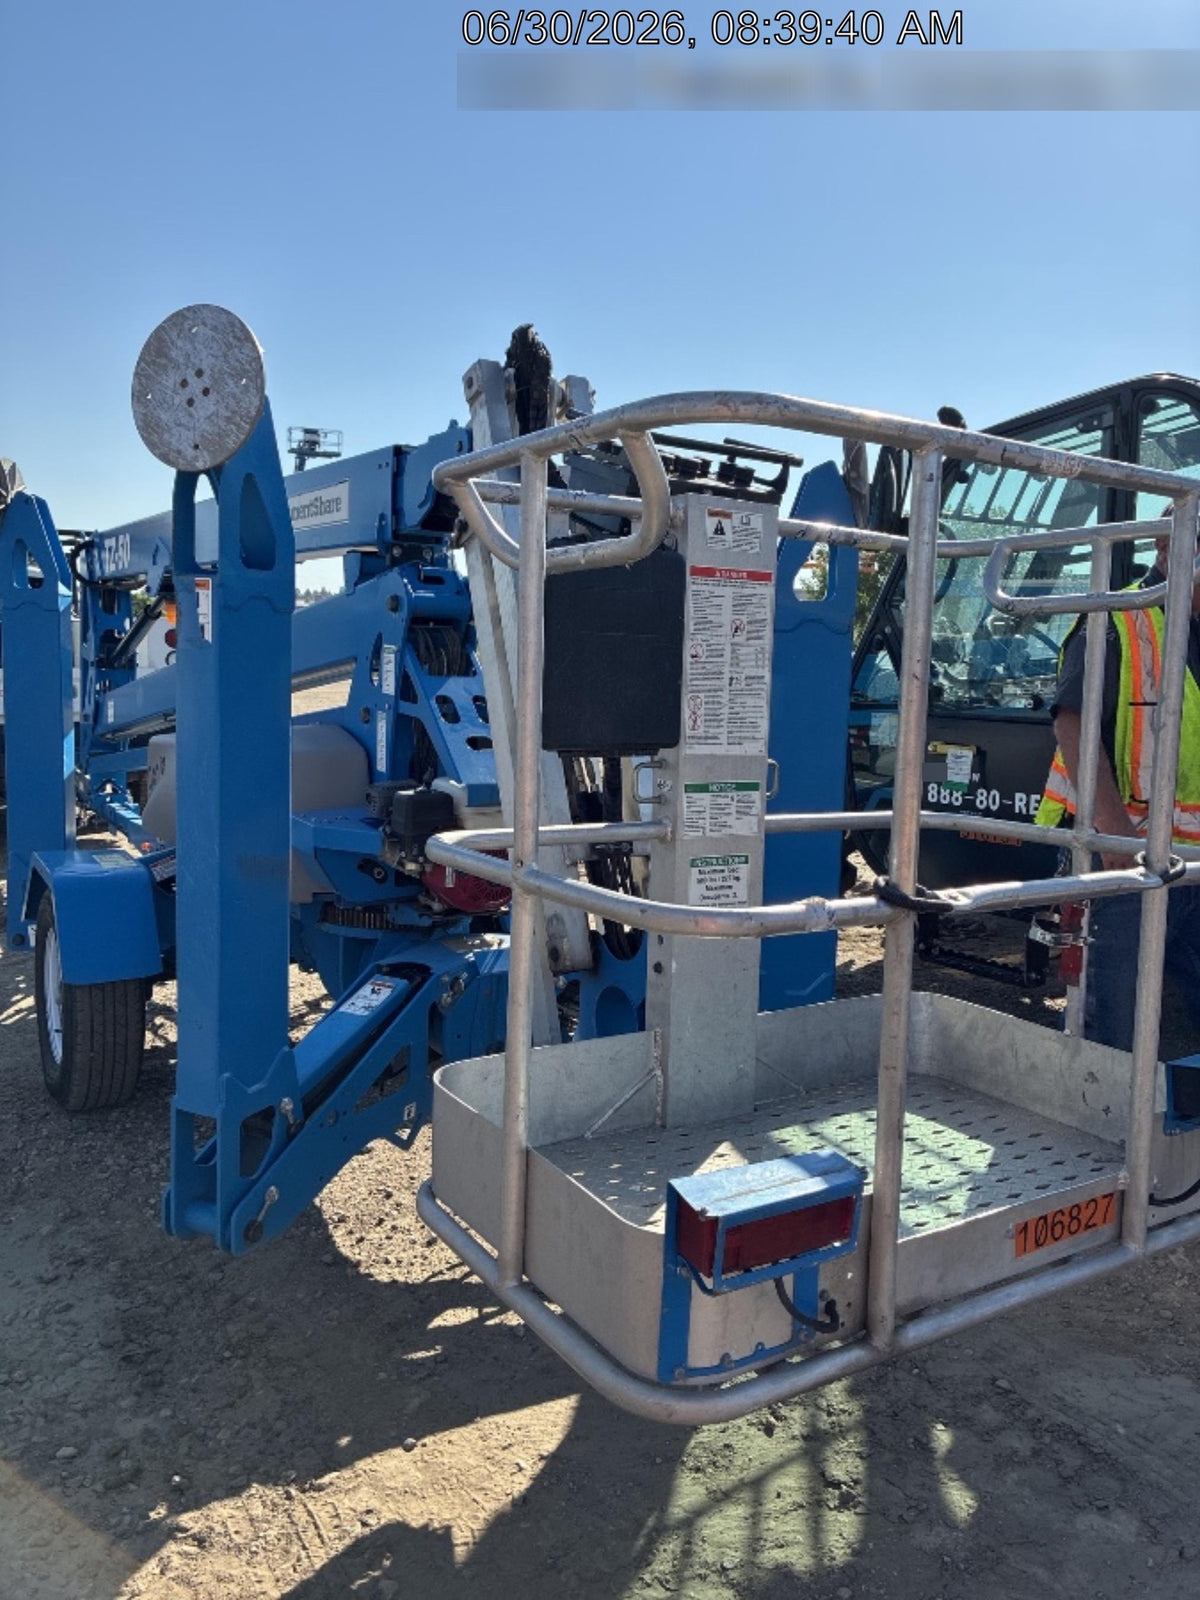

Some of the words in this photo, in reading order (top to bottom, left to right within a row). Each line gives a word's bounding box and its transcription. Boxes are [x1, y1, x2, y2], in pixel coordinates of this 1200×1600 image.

[104, 532, 131, 573] TZ-50
[709, 783, 737, 792] NOTICE
[1018, 1192, 1115, 1254] 106827
